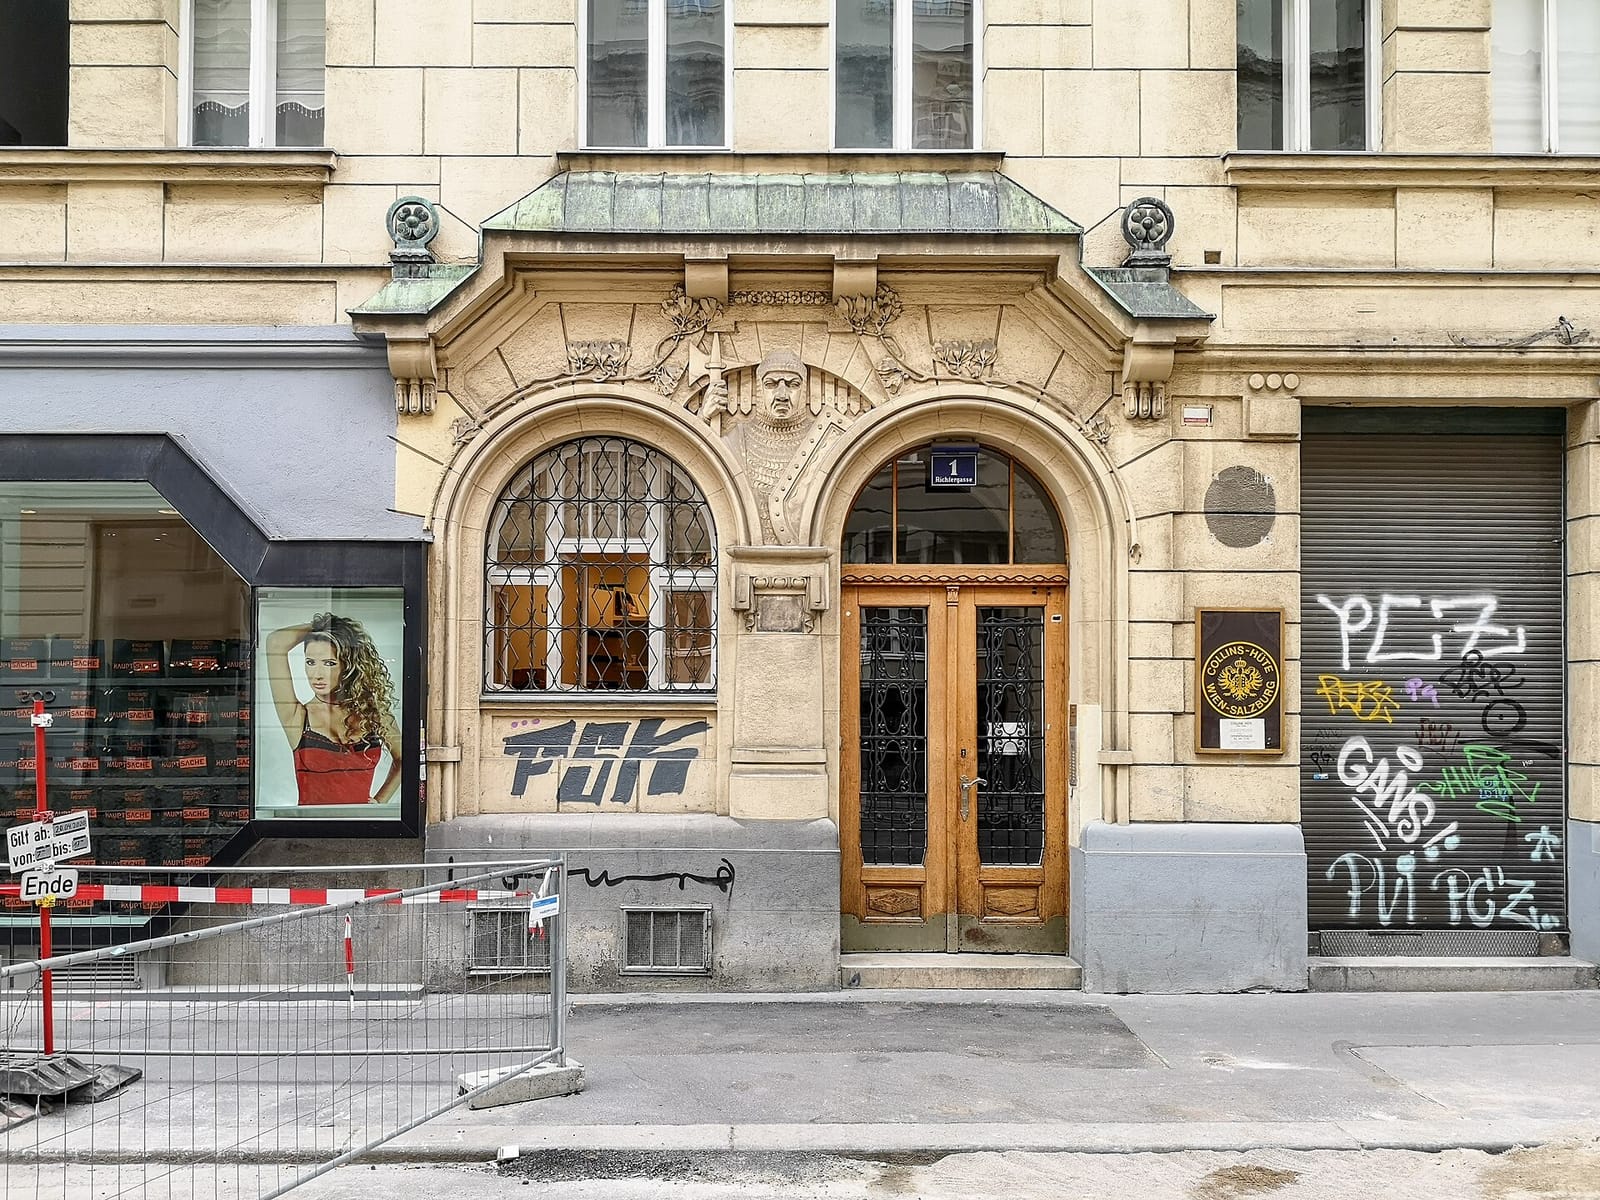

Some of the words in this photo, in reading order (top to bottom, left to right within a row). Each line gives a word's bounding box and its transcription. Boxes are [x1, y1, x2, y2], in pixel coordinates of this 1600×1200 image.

[949, 459, 958, 476] 1
[1207, 645, 1274, 676] COLLINS-HÜTE
[1207, 681, 1275, 715] WIEN-SALZBURG
[10, 829, 29, 848] Gilt
[34, 826, 51, 842] ab:
[12, 851, 36, 867] von:
[52, 841, 72, 857] bis:
[25, 874, 73, 896] Ende
